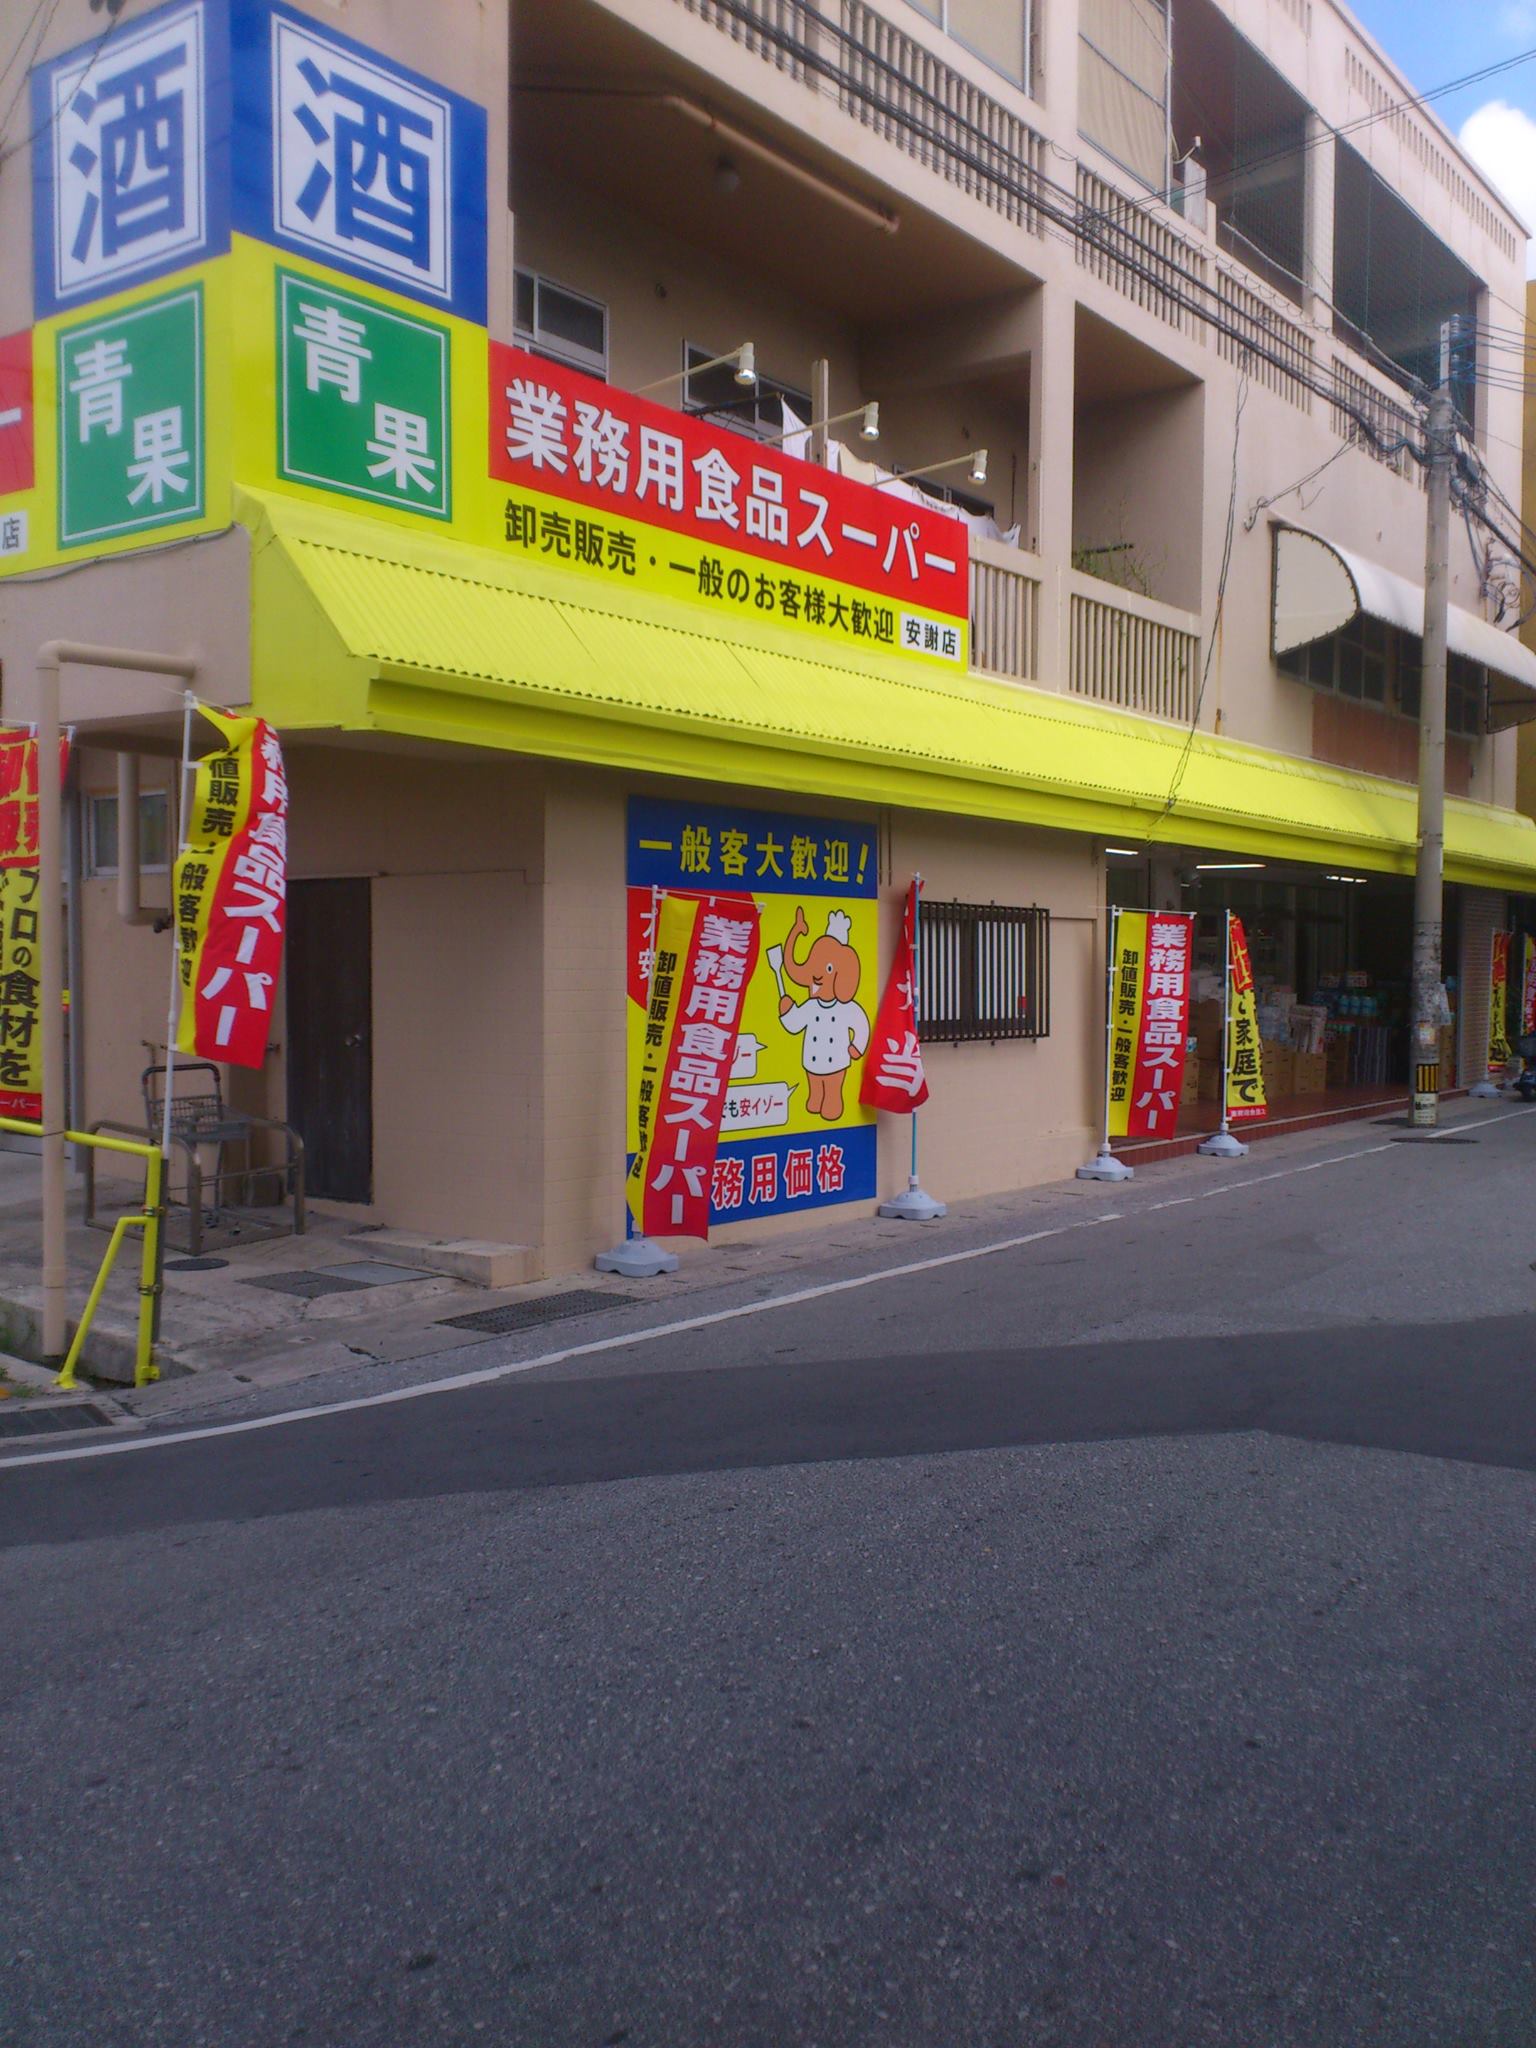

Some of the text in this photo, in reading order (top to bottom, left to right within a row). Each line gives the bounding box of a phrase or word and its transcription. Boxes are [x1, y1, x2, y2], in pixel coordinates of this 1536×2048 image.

[69, 42, 188, 264] 酒
[293, 58, 433, 272] 酒
[69, 338, 191, 506] 青果
[293, 302, 436, 493] 青果
[505, 377, 957, 580] 業務用食品スーパー
[504, 499, 895, 645] 卸売販売・一般のお客様大歓迎
[904, 617, 957, 657] 安謝店
[639, 824, 870, 885] 一般客大歓迎！
[651, 914, 754, 1225] 業務用食品スーパー
[1136, 923, 1188, 1131] 業務用食品スーパー
